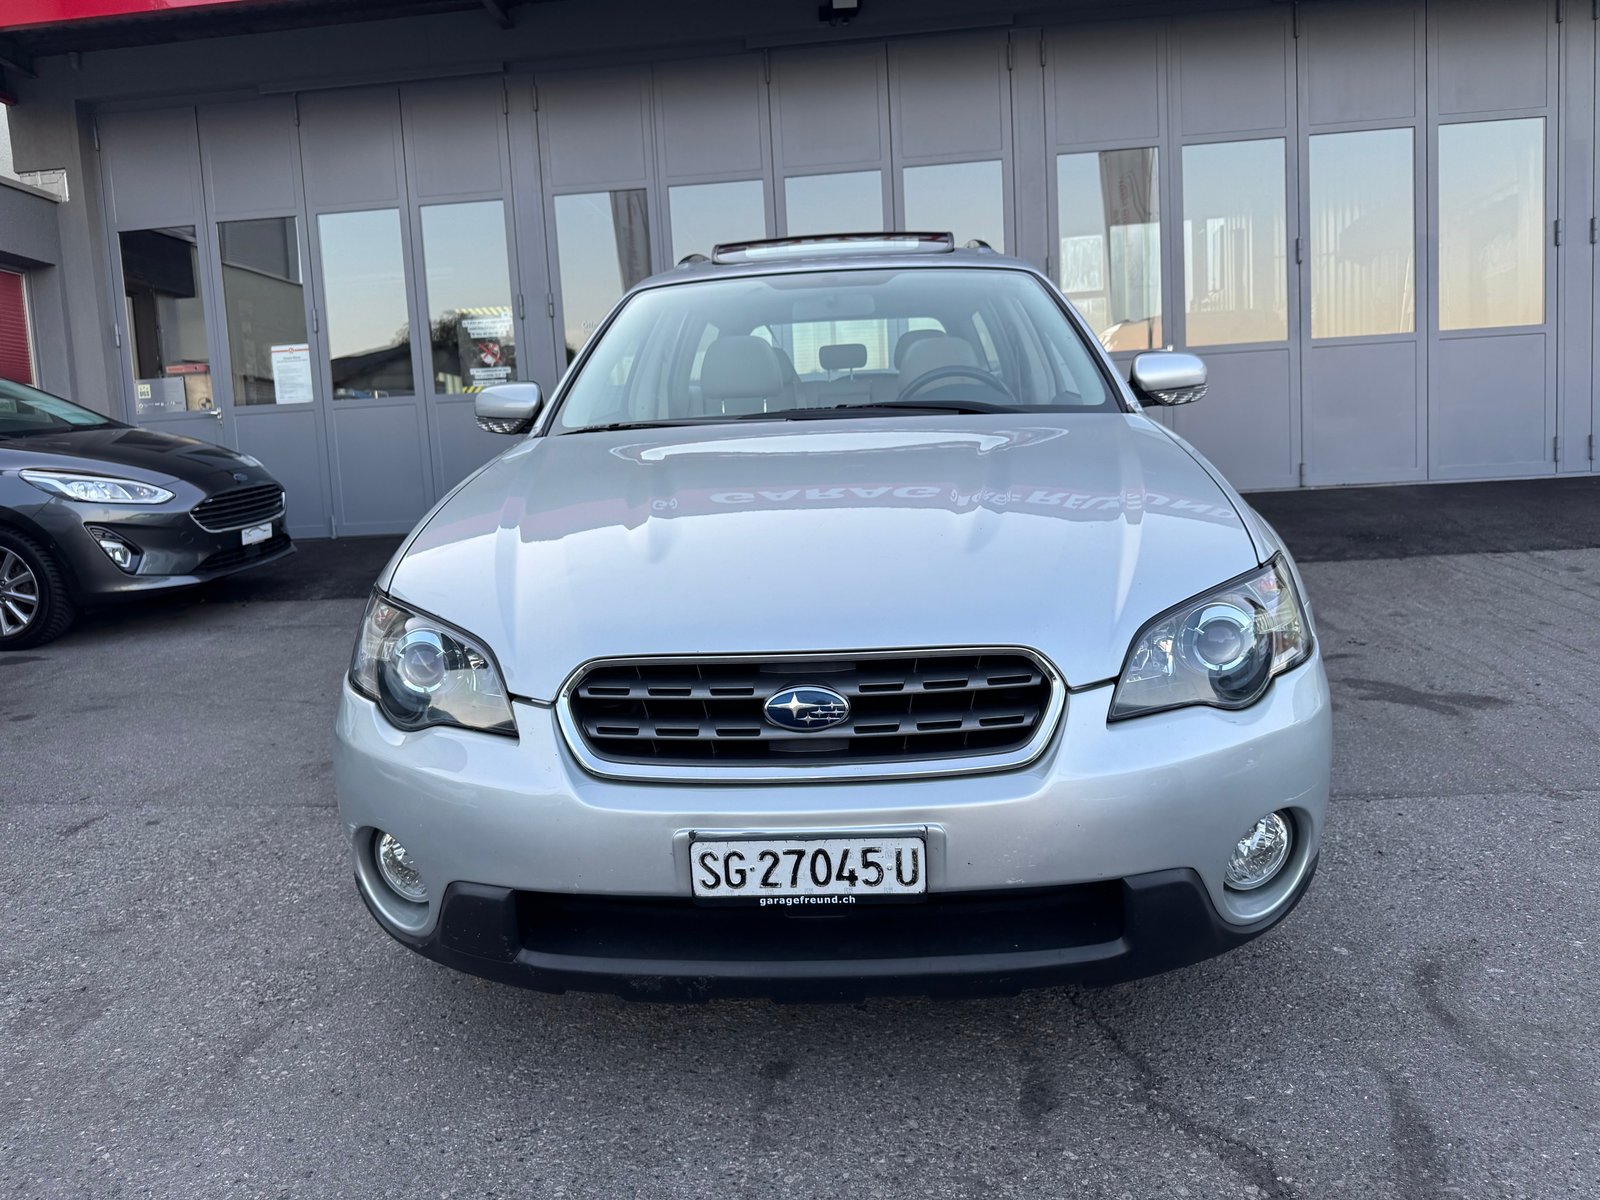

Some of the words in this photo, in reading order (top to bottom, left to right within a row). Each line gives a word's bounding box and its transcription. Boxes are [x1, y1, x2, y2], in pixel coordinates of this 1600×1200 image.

[699, 849, 747, 890] SG
[758, 846, 885, 889] 27045
[894, 846, 920, 888] U
[759, 895, 856, 906] garagefreund.ch
